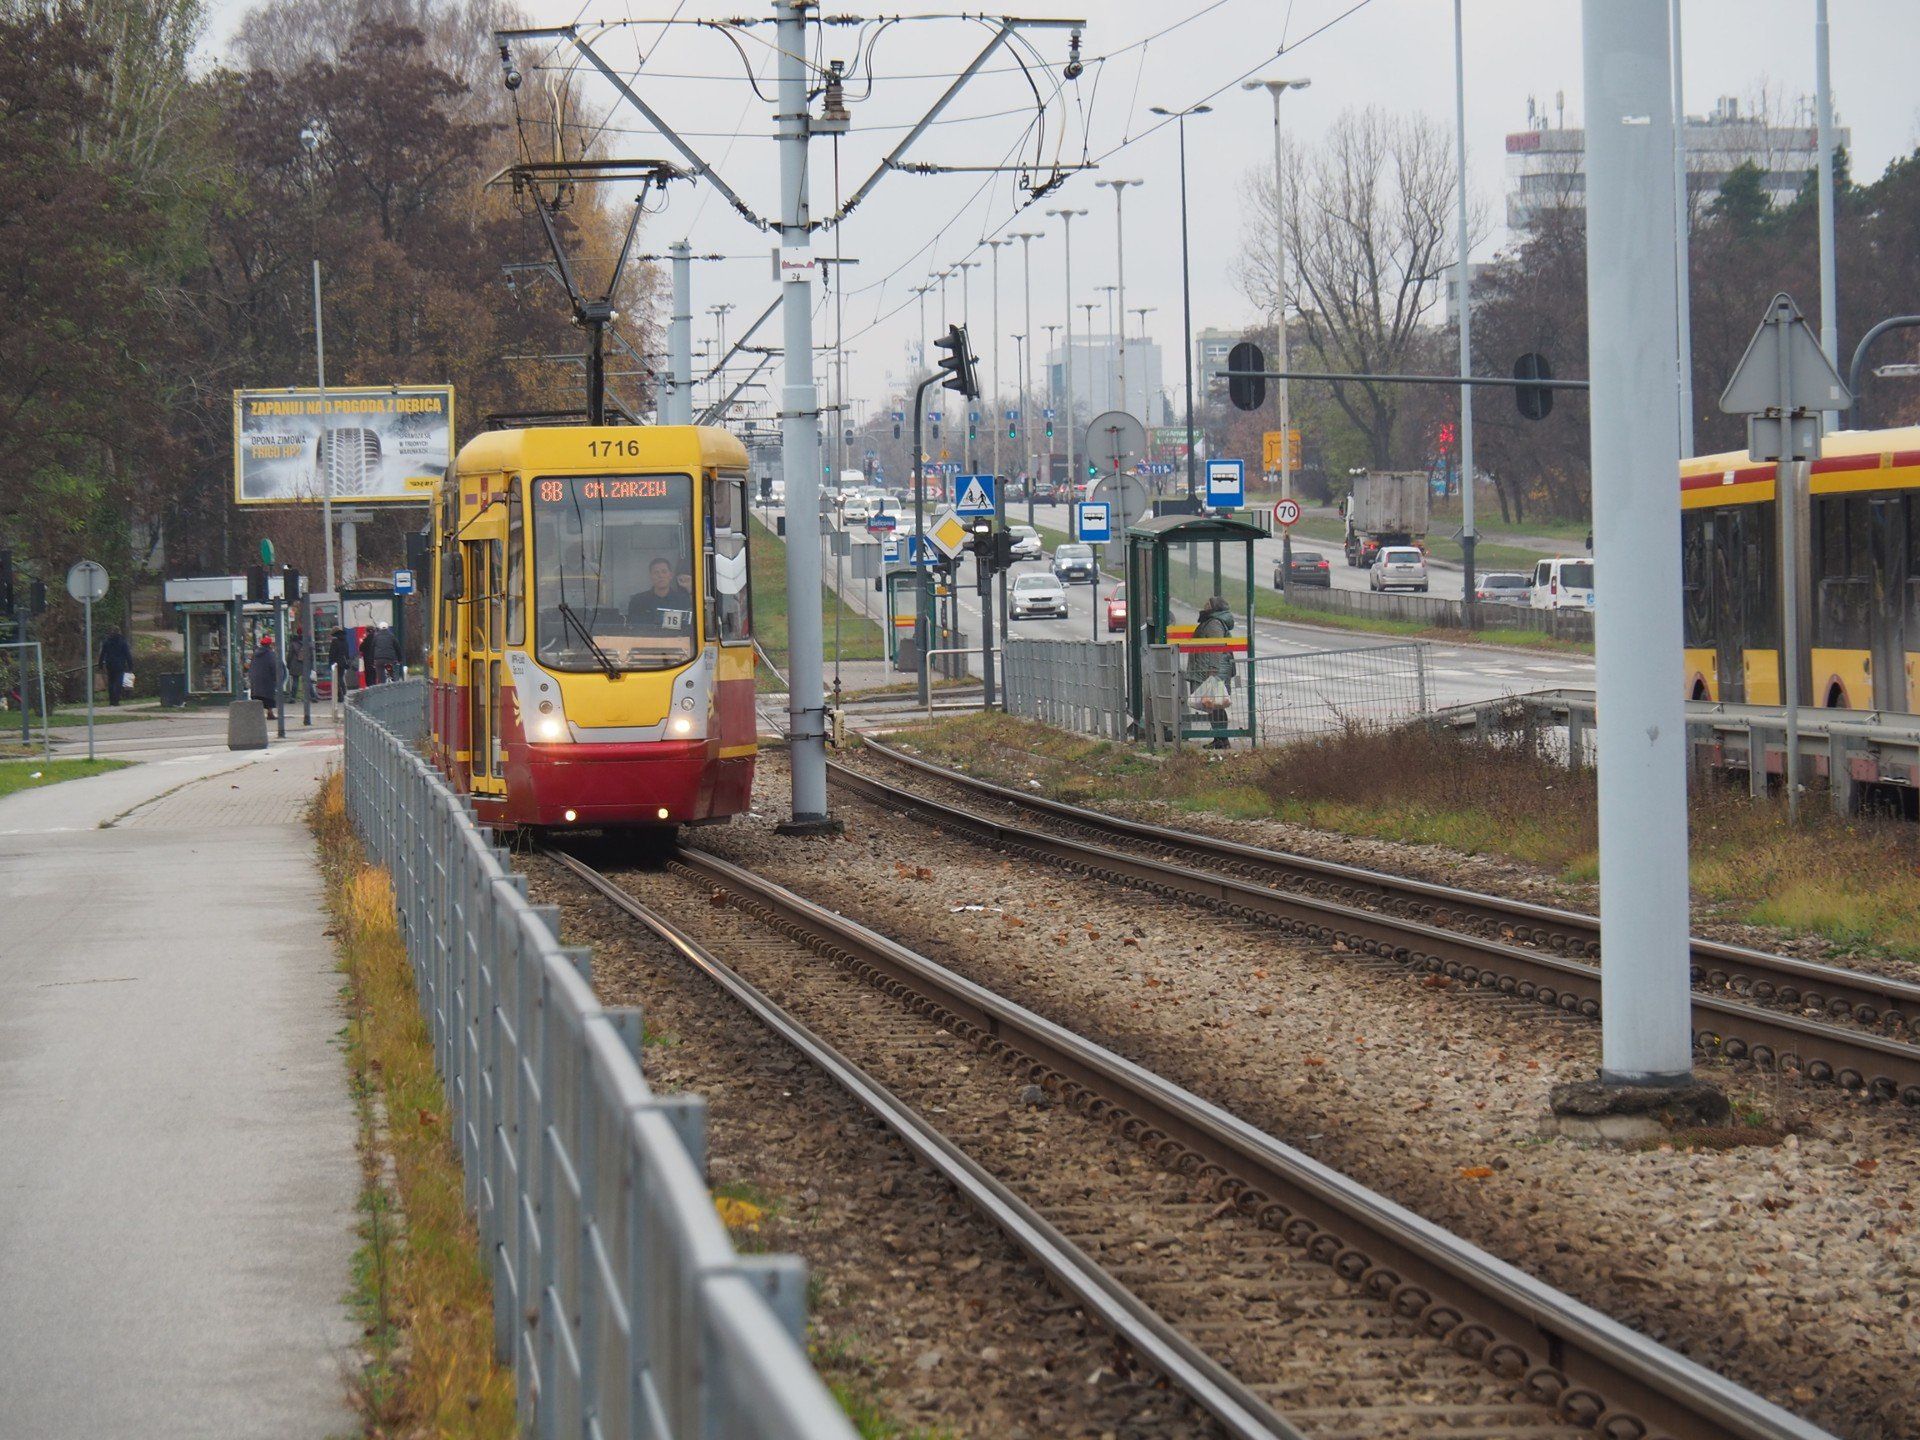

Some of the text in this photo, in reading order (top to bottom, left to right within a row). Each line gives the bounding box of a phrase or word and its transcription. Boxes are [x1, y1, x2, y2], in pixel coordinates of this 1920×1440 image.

[250, 401, 304, 416] ZAPANUJ
[387, 399, 394, 413] Z
[396, 398, 442, 415] DĘBICĄ
[251, 434, 307, 445] OPONA ZIMOWA
[252, 445, 280, 459] FRIGO
[588, 440, 640, 457] 1716
[540, 481, 563, 503] 8B
[1280, 506, 1296, 518] 70
[667, 615, 679, 626] 16
